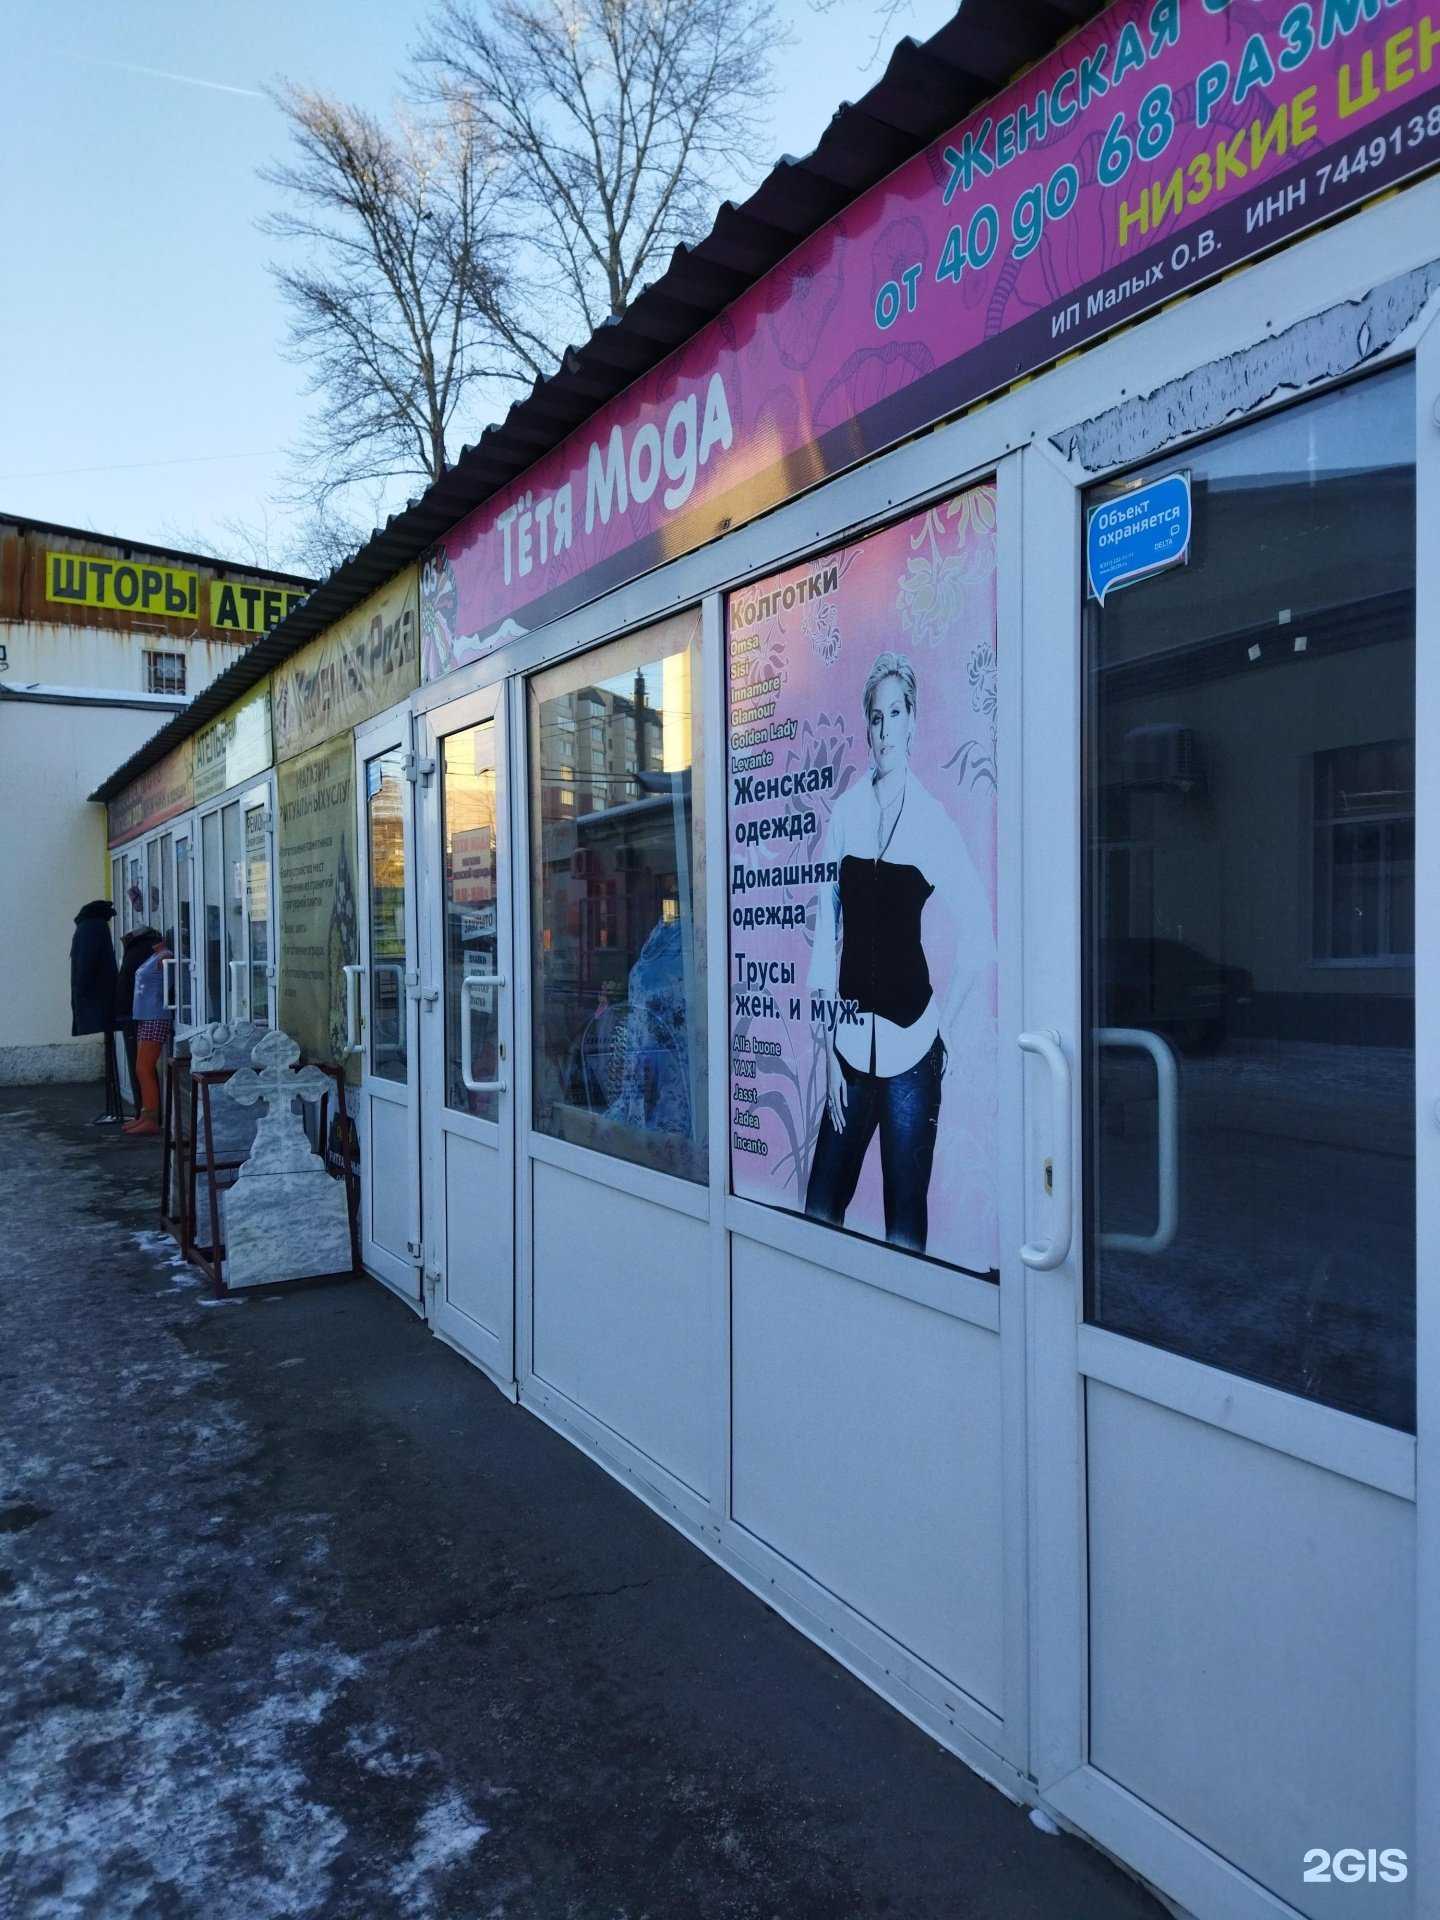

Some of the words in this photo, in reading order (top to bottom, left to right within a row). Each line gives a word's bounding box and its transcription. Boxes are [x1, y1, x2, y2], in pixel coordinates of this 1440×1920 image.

[936, 204, 1000, 283] 40
[1098, 84, 1175, 187] 68
[1195, 0, 1406, 128] РАЗМ
[1119, 84, 1318, 246] НИЗКИЕ
[1051, 303, 1080, 338] ИП
[1087, 261, 1165, 320] Малых
[1171, 229, 1222, 271] О.В.
[1246, 177, 1306, 234] ИНН
[1099, 500, 1150, 530] Объект
[1099, 506, 1180, 547] охраняется
[53, 557, 197, 614] ШТОРЫ
[730, 566, 838, 632] Колготки
[730, 635, 760, 656] Omsa
[730, 657, 750, 680] Sisi
[731, 676, 781, 703] Innamore
[731, 702, 776, 726] Glamour
[731, 730, 769, 751] Golden
[769, 718, 798, 741] Lady
[731, 750, 774, 774] Levante
[734, 766, 833, 806] Женская
[735, 811, 817, 847] одежда
[732, 861, 839, 894] Домашняя
[733, 904, 806, 930] одежда
[735, 953, 795, 990] Трусы
[735, 994, 781, 1020] жен.
[789, 998, 801, 1021] и
[811, 998, 865, 1032] муж.
[733, 1036, 751, 1053] Alla
[752, 1037, 782, 1057] buone
[734, 1108, 760, 1130] Jadea
[734, 1133, 768, 1156] Incanto
